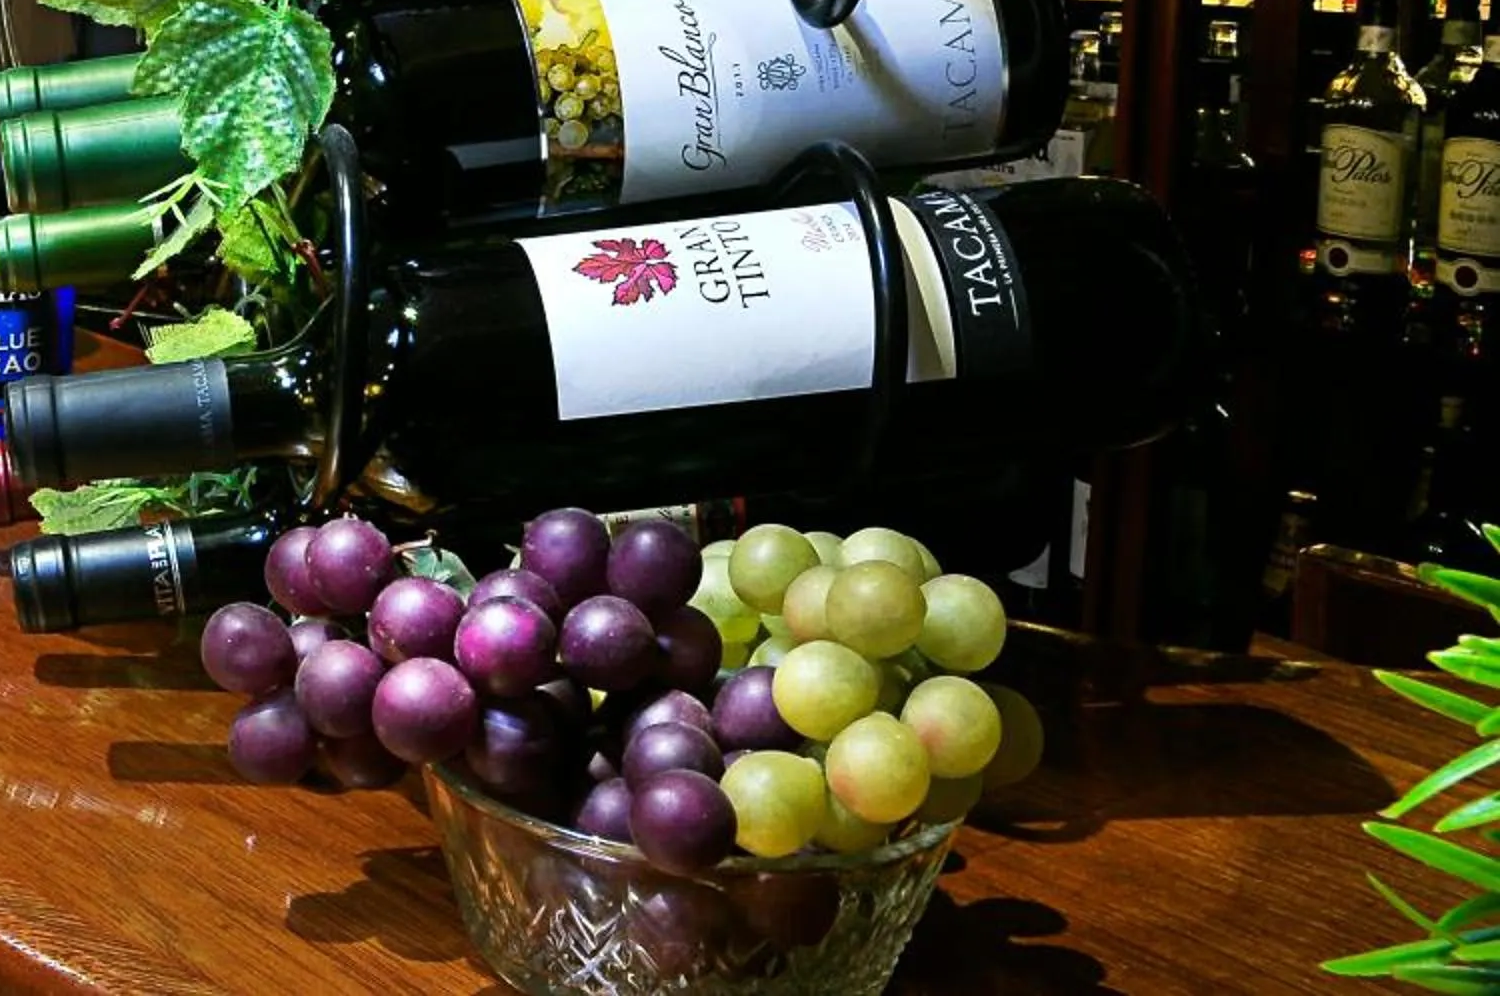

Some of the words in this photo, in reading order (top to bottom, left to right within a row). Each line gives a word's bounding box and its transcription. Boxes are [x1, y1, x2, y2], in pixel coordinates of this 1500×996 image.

[681, 102, 727, 170] Gran
[673, 226, 731, 303] GRAN
[711, 221, 771, 309] TINTO
[916, 191, 1002, 317] TACAMA
